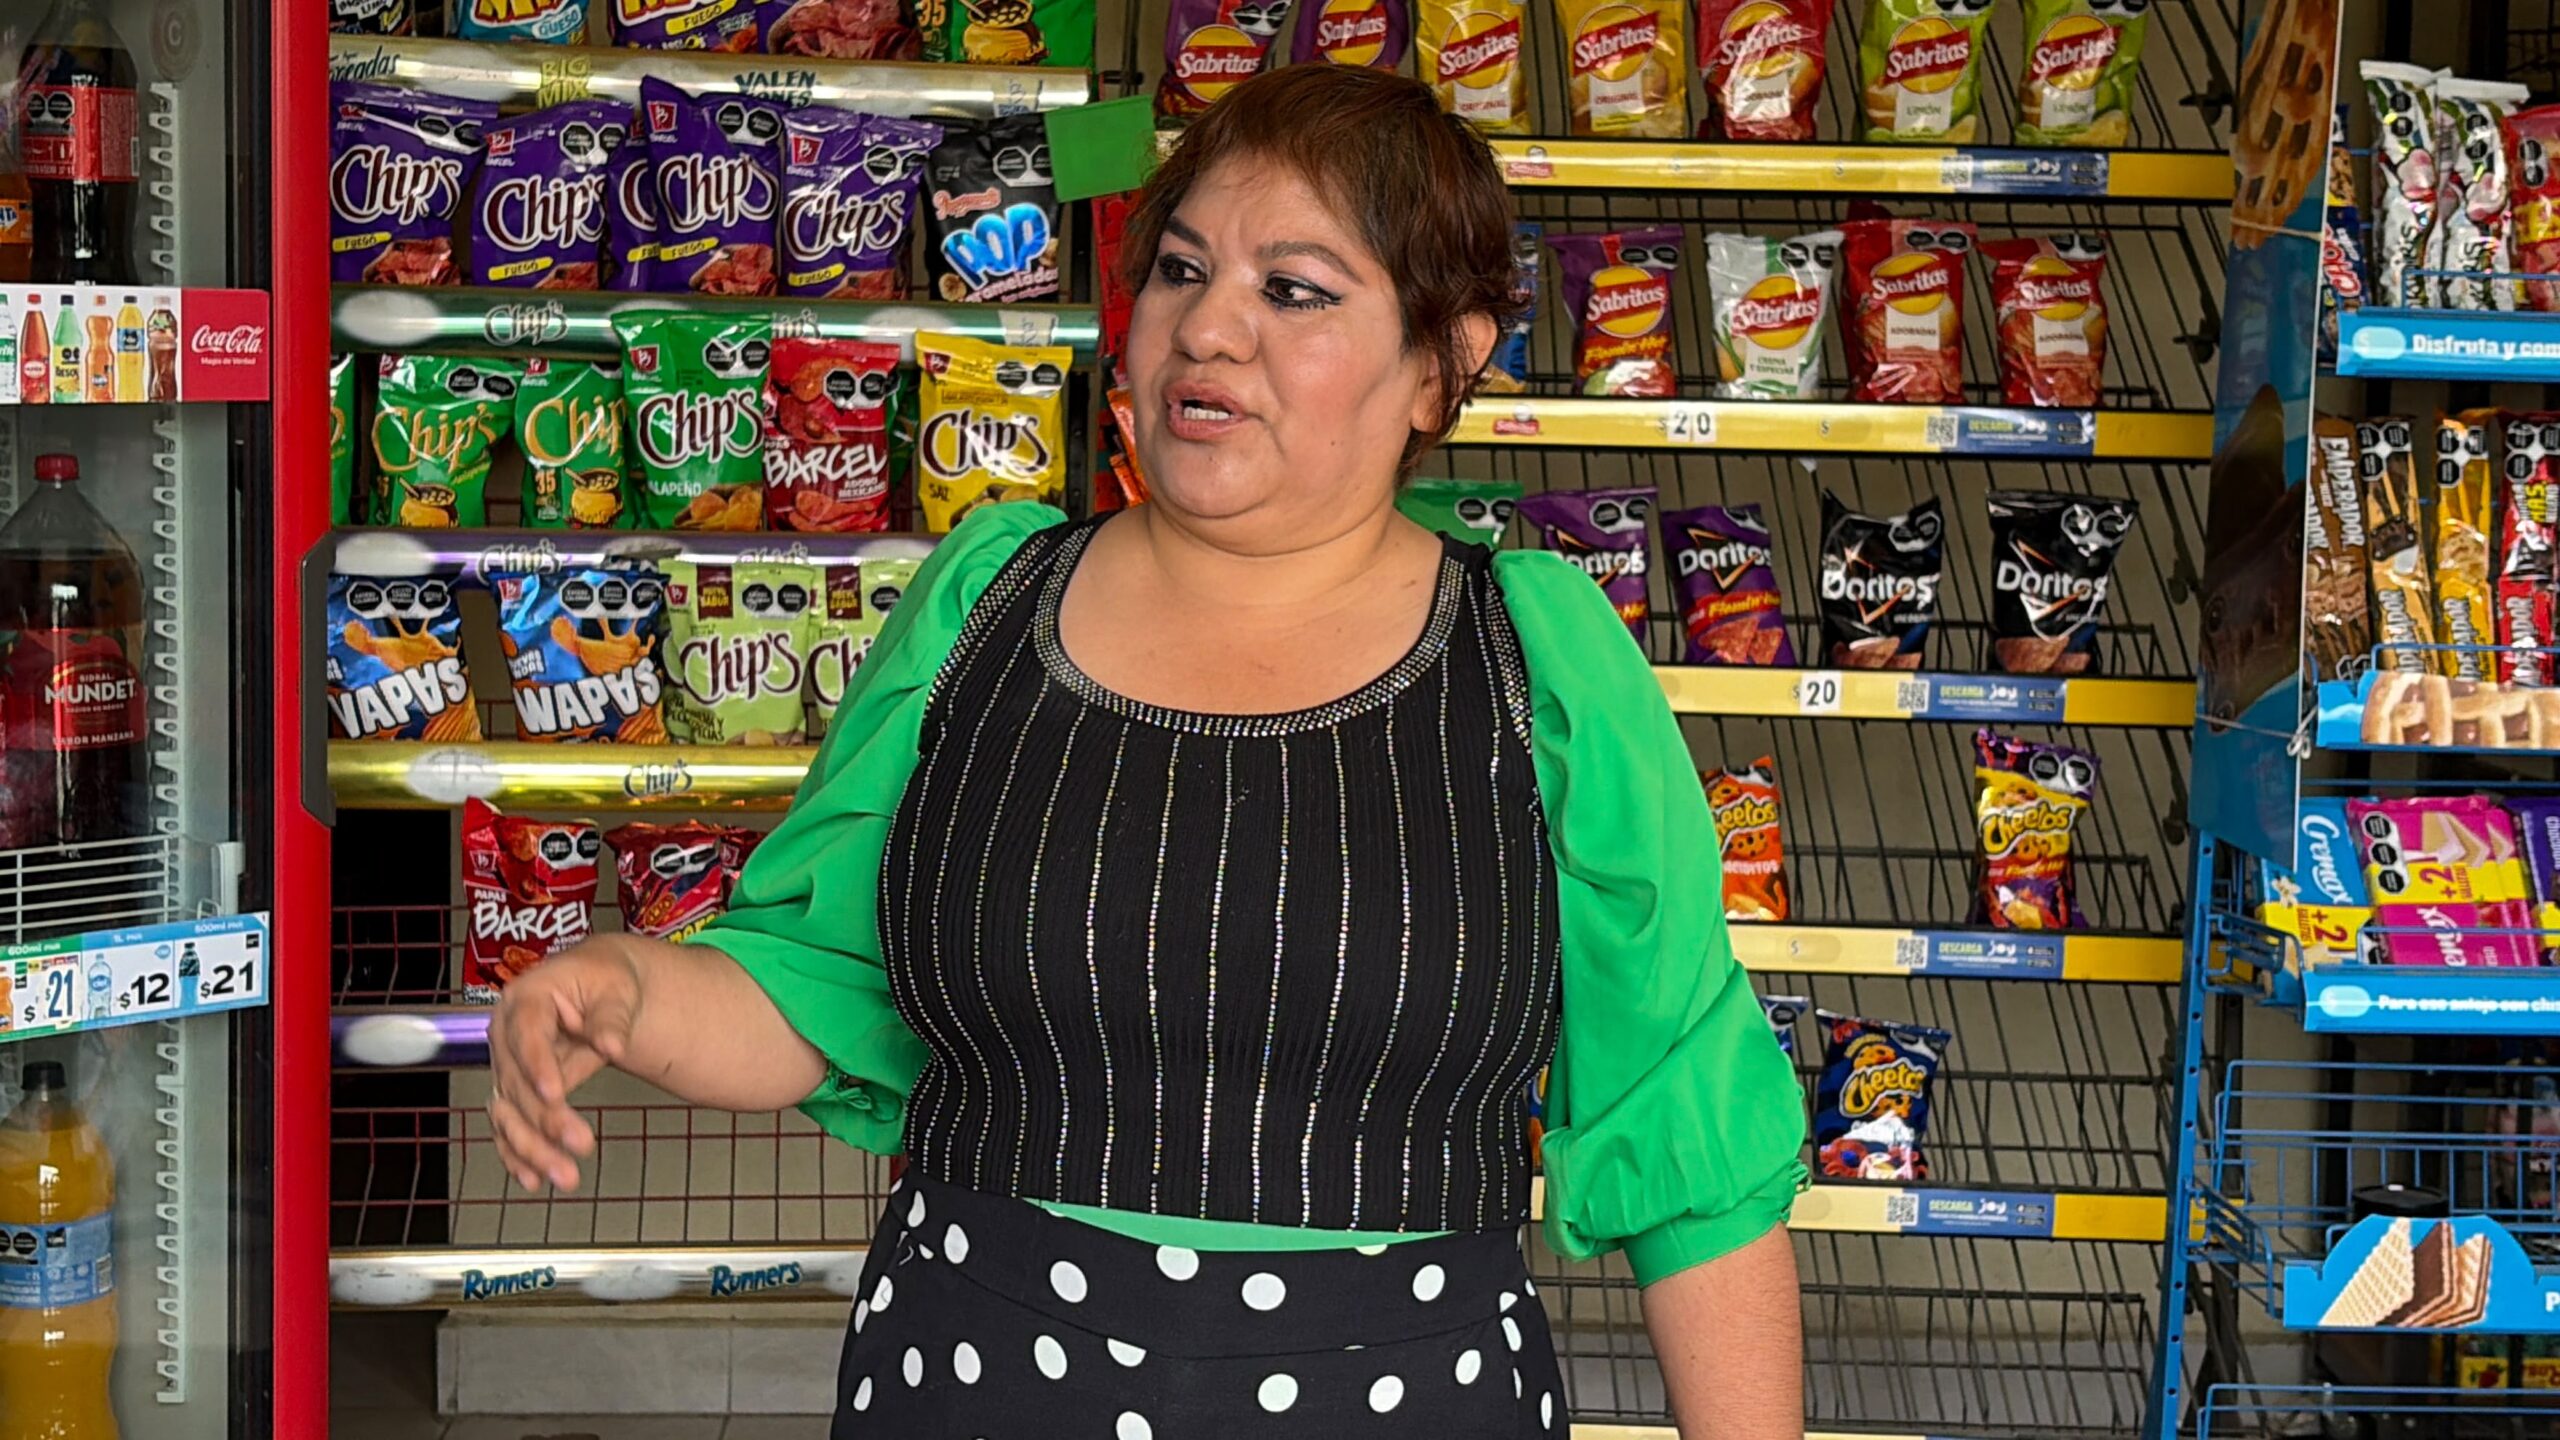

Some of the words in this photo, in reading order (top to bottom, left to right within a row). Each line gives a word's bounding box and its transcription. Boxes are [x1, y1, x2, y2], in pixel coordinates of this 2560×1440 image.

[539, 10, 579, 37] QUESO
[684, 4, 723, 28] FUEGO
[1317, 15, 1386, 47] Sabritas
[1439, 23, 1520, 75] Sabritas
[1574, 24, 1655, 68] Sabritas
[1719, 23, 1801, 65] Sabritas
[1887, 39, 1969, 79] Sabritas
[2032, 32, 2117, 75] Sabritas
[542, 57, 590, 79] BIG
[1176, 51, 1261, 79] Sabritas
[538, 78, 588, 108] MIX
[330, 145, 463, 225] Chip's
[784, 188, 906, 262] Chip's
[344, 236, 377, 249] FUEGO
[671, 241, 706, 257] FUEGO
[940, 202, 1049, 291] POP
[504, 262, 538, 276] FUEGO
[1872, 267, 1949, 300] Sabritas
[1587, 286, 1666, 322] Sabritas
[2019, 278, 2092, 303] Sabritas
[483, 301, 569, 346] Chip's
[1733, 297, 1819, 328] Sabritas
[2412, 334, 2498, 356] Disfruta
[2502, 339, 2516, 361] y
[371, 402, 498, 473] Chip's
[638, 388, 765, 469] Chip's
[1673, 412, 1712, 435] 20
[535, 470, 556, 495] 35
[763, 443, 888, 489] BARCEL
[928, 483, 951, 502] SAL
[2319, 436, 2366, 554] EMPERADOR
[1677, 541, 1773, 577] Doritos
[1821, 567, 1940, 602] Doritos
[1996, 561, 2108, 602] Doritos
[79, 672, 114, 682] SIDRAL
[680, 632, 802, 706] Chip's
[45, 678, 137, 705] MUNDET
[512, 657, 662, 736] WAPAS
[1806, 679, 1836, 706] 20
[91, 730, 135, 743] MANZANA
[623, 758, 694, 798] Chip's
[1982, 801, 2070, 855] Cheetos
[474, 889, 507, 902] PAPAS
[8, 944, 43, 957] 600ml
[2378, 993, 2417, 1011] Para
[461, 1266, 557, 1300] Runners
[708, 1261, 802, 1297] Runners
